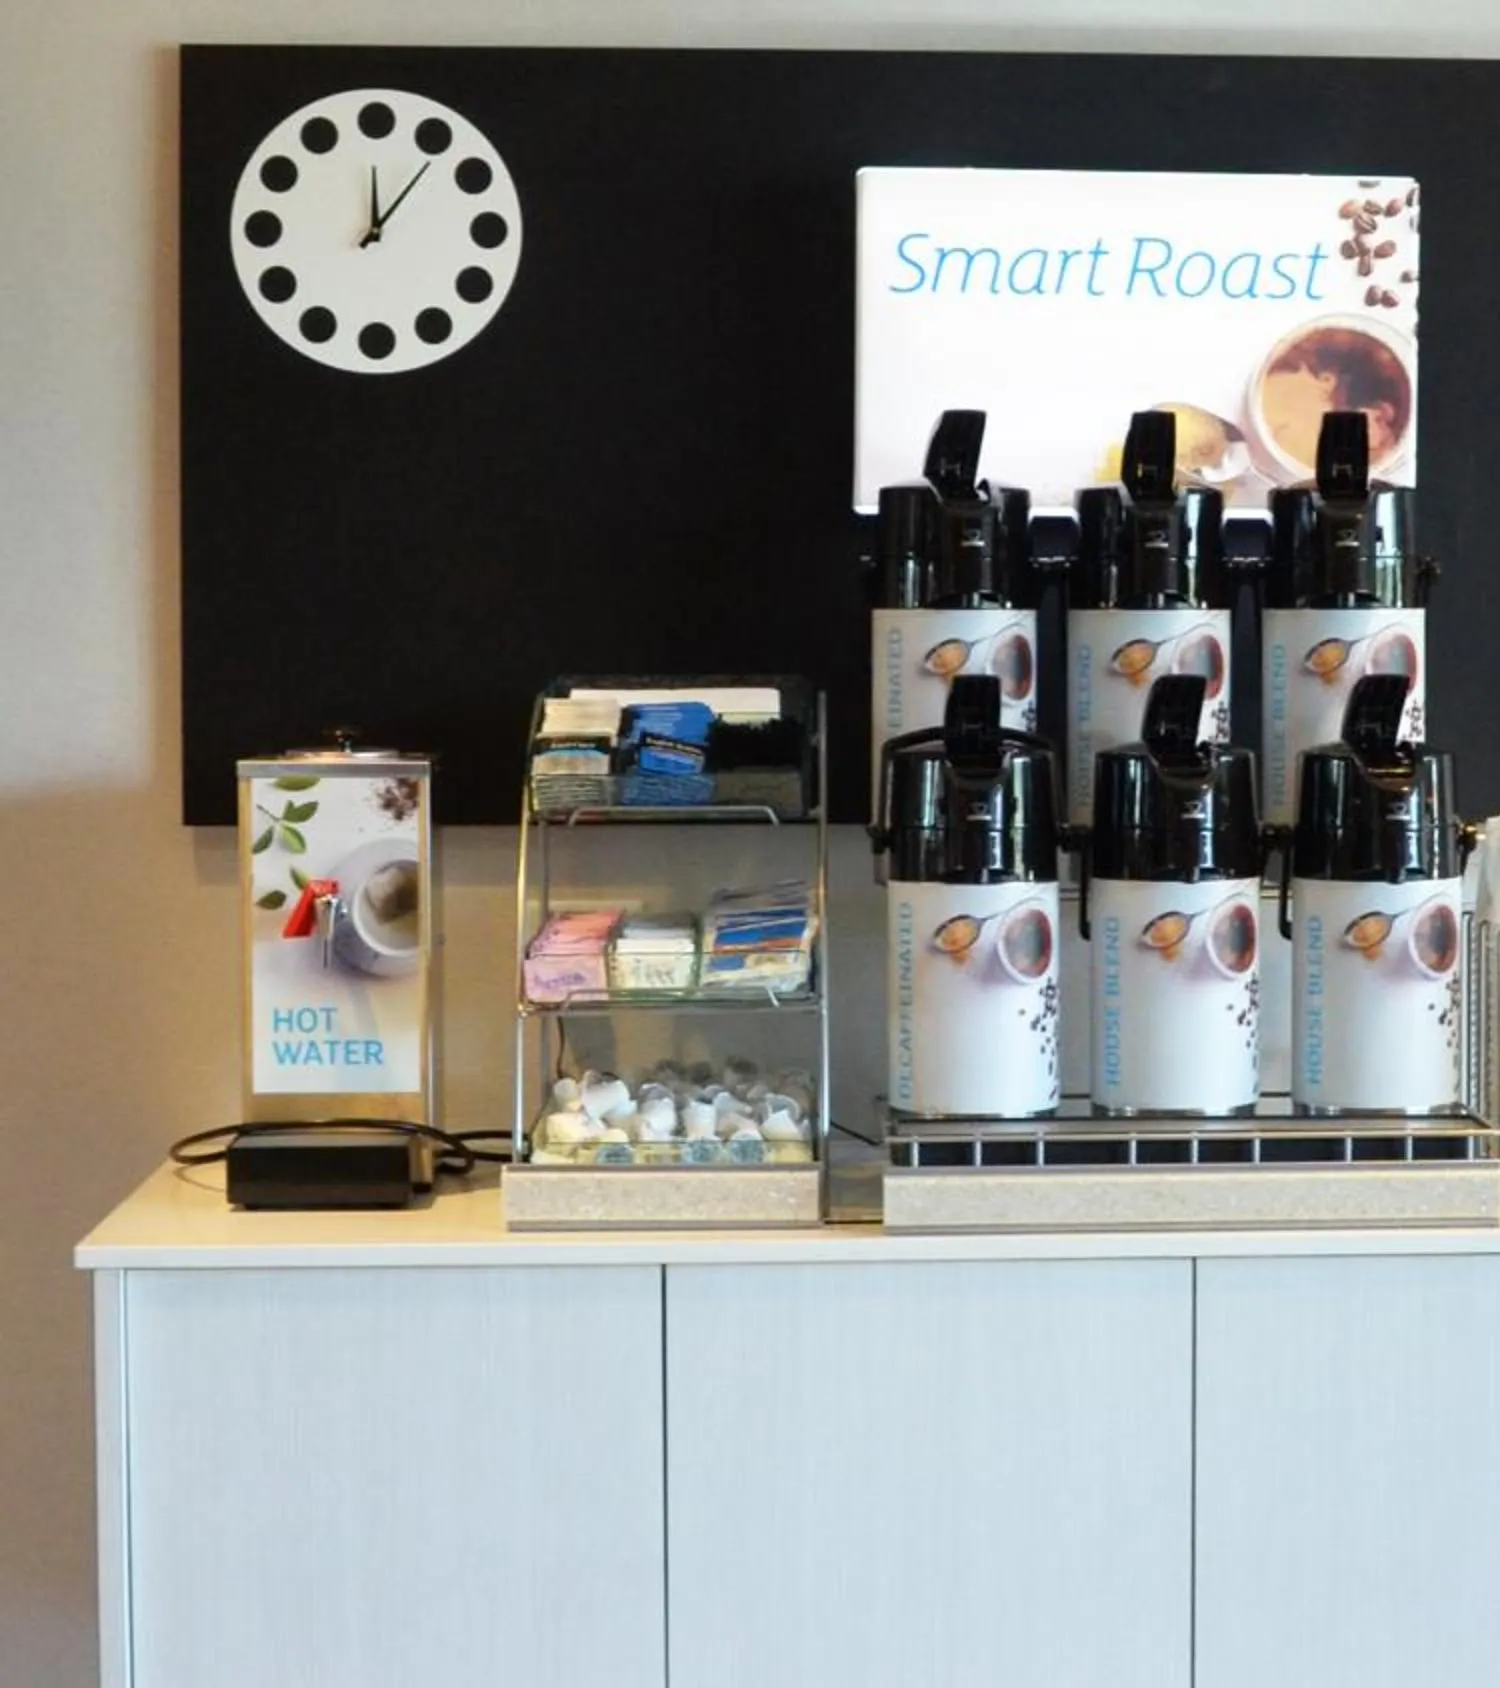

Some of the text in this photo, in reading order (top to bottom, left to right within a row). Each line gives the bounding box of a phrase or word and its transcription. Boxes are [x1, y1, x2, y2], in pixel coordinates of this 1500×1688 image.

[889, 232, 1329, 300] Smart Roast
[1075, 644, 1092, 806] HOUSE BLEND
[1270, 644, 1286, 806] HOUSE BLEND
[272, 1007, 338, 1034] HOT
[272, 1040, 384, 1066] WATER
[898, 902, 914, 1099] DECAFFEINATED
[1104, 916, 1121, 1086] HOUSE BLEND
[1307, 916, 1323, 1086] HOUSE BLEND
